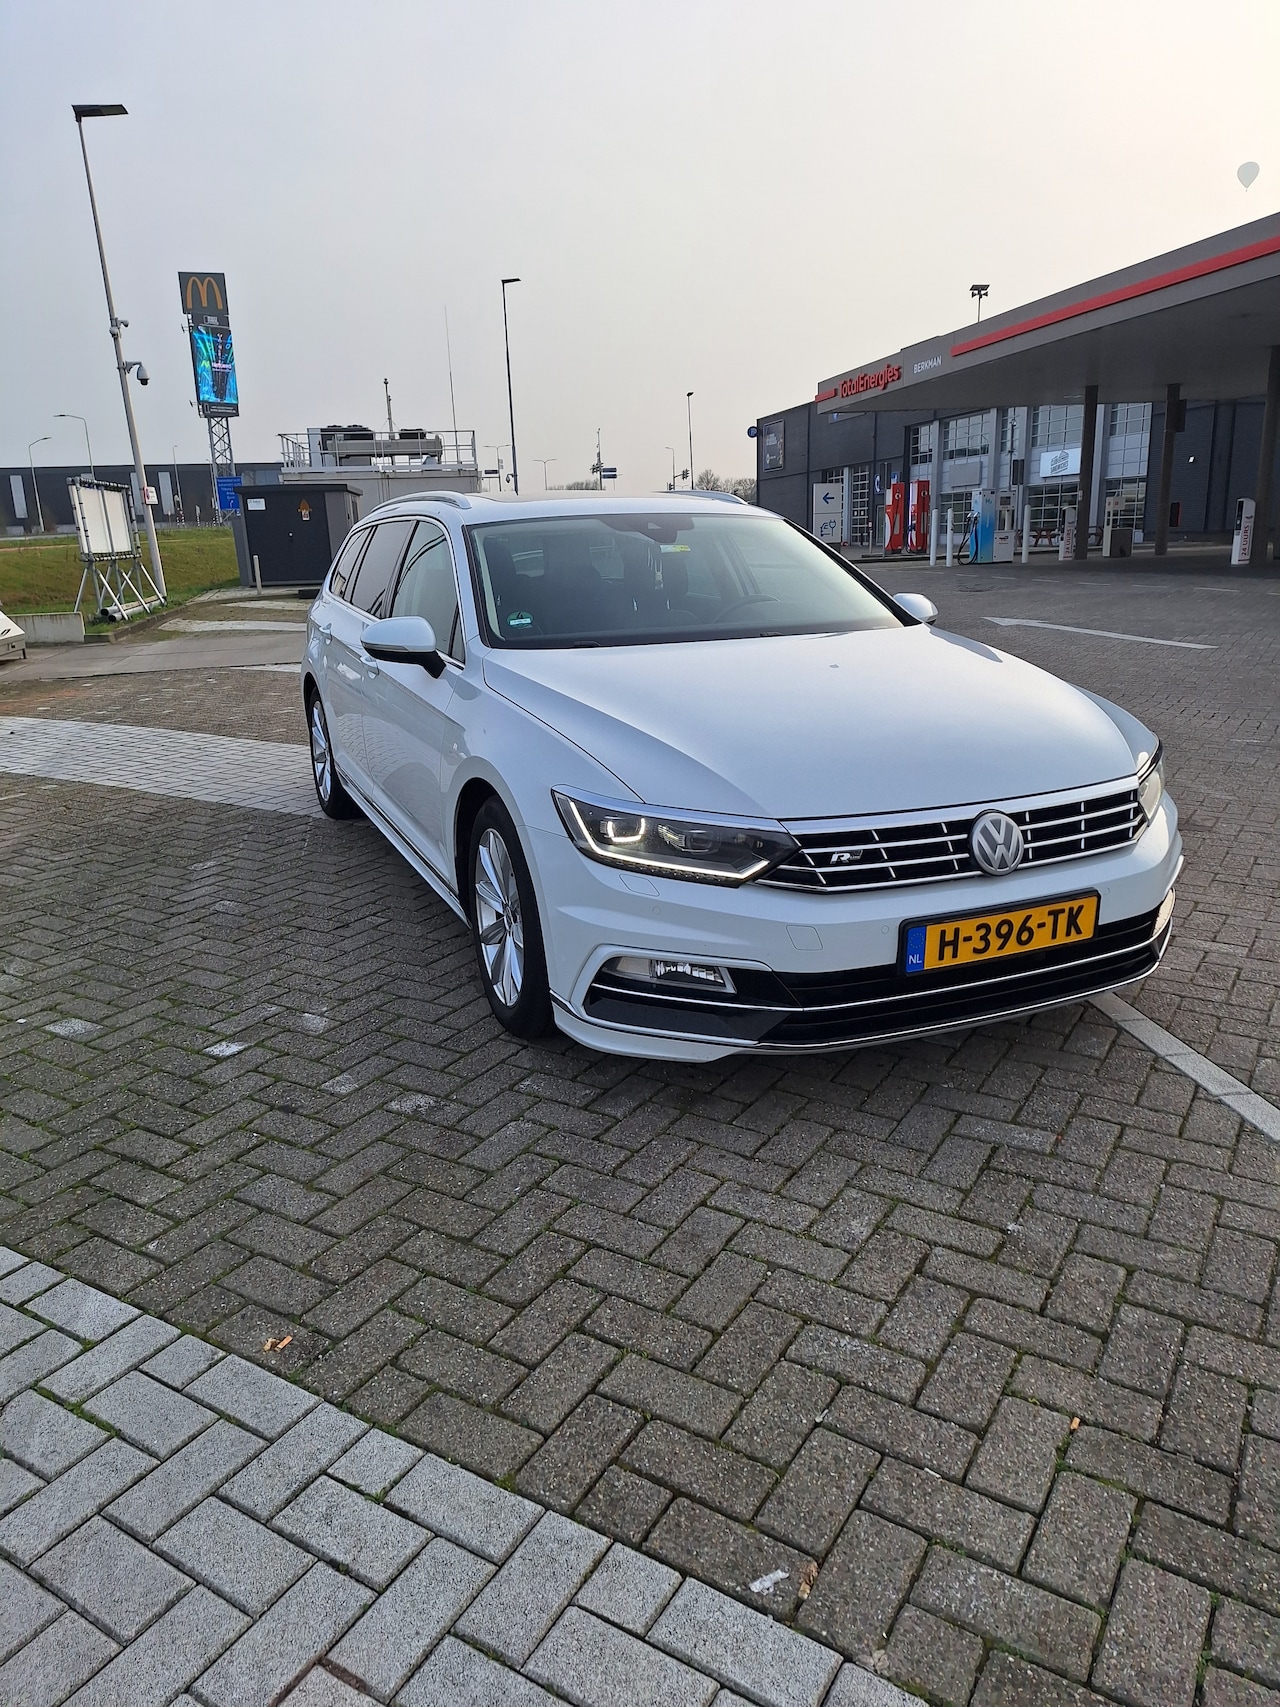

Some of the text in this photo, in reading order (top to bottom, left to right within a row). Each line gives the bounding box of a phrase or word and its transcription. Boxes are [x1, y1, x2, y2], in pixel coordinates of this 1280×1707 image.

[186, 276, 223, 309] M
[913, 356, 942, 374] BERKMAN
[839, 364, 901, 398] TotalEnergies
[1241, 547, 1247, 556] 24
[938, 905, 1085, 961] H-396-TK
[908, 954, 922, 965] NL
